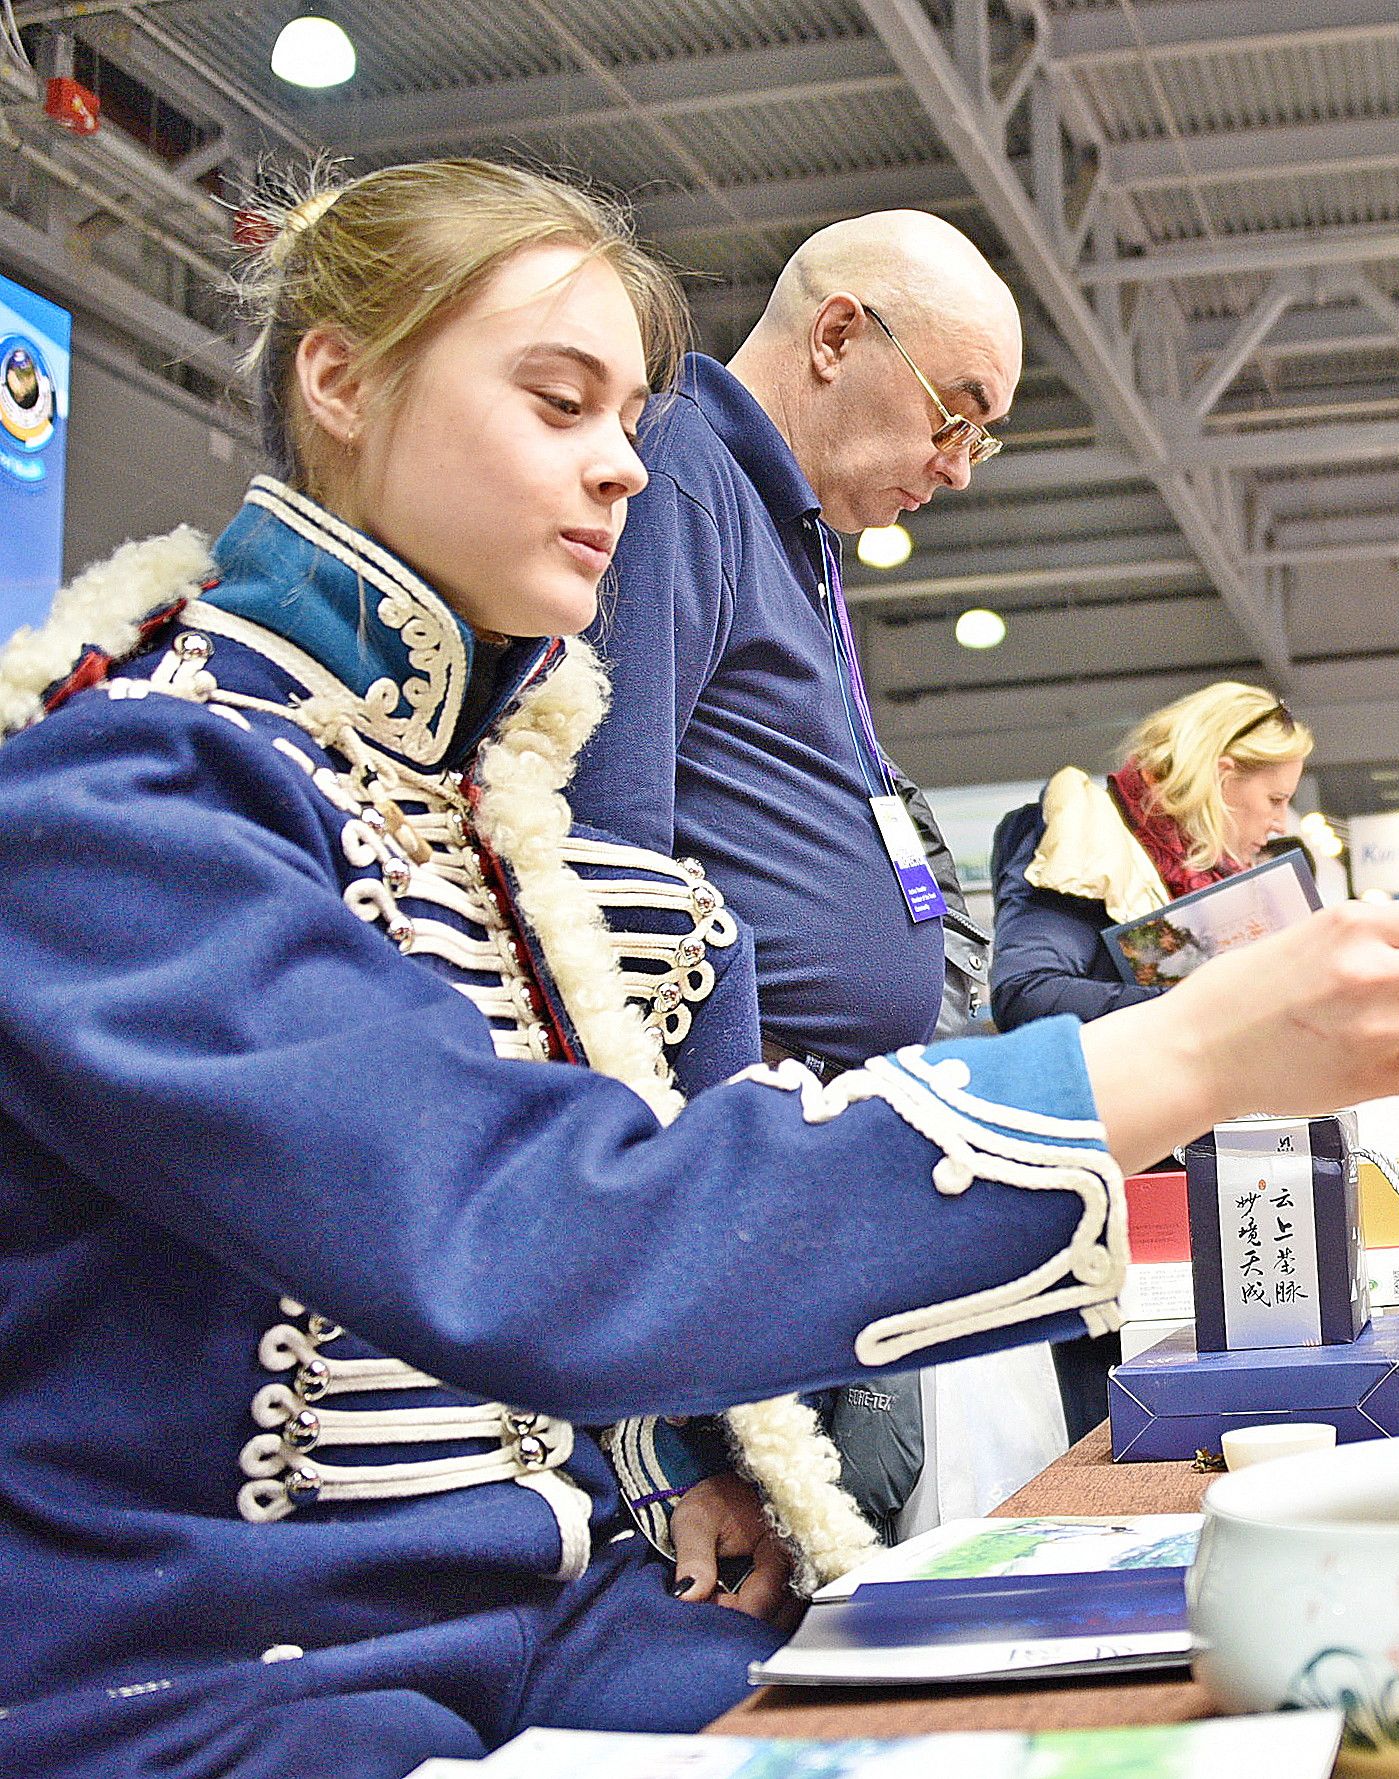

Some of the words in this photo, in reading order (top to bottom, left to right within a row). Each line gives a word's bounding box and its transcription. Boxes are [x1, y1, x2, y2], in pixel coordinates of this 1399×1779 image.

[1236, 1192, 1272, 1308] 妙境天成
[1270, 1188, 1309, 1304] 云上茶脉
